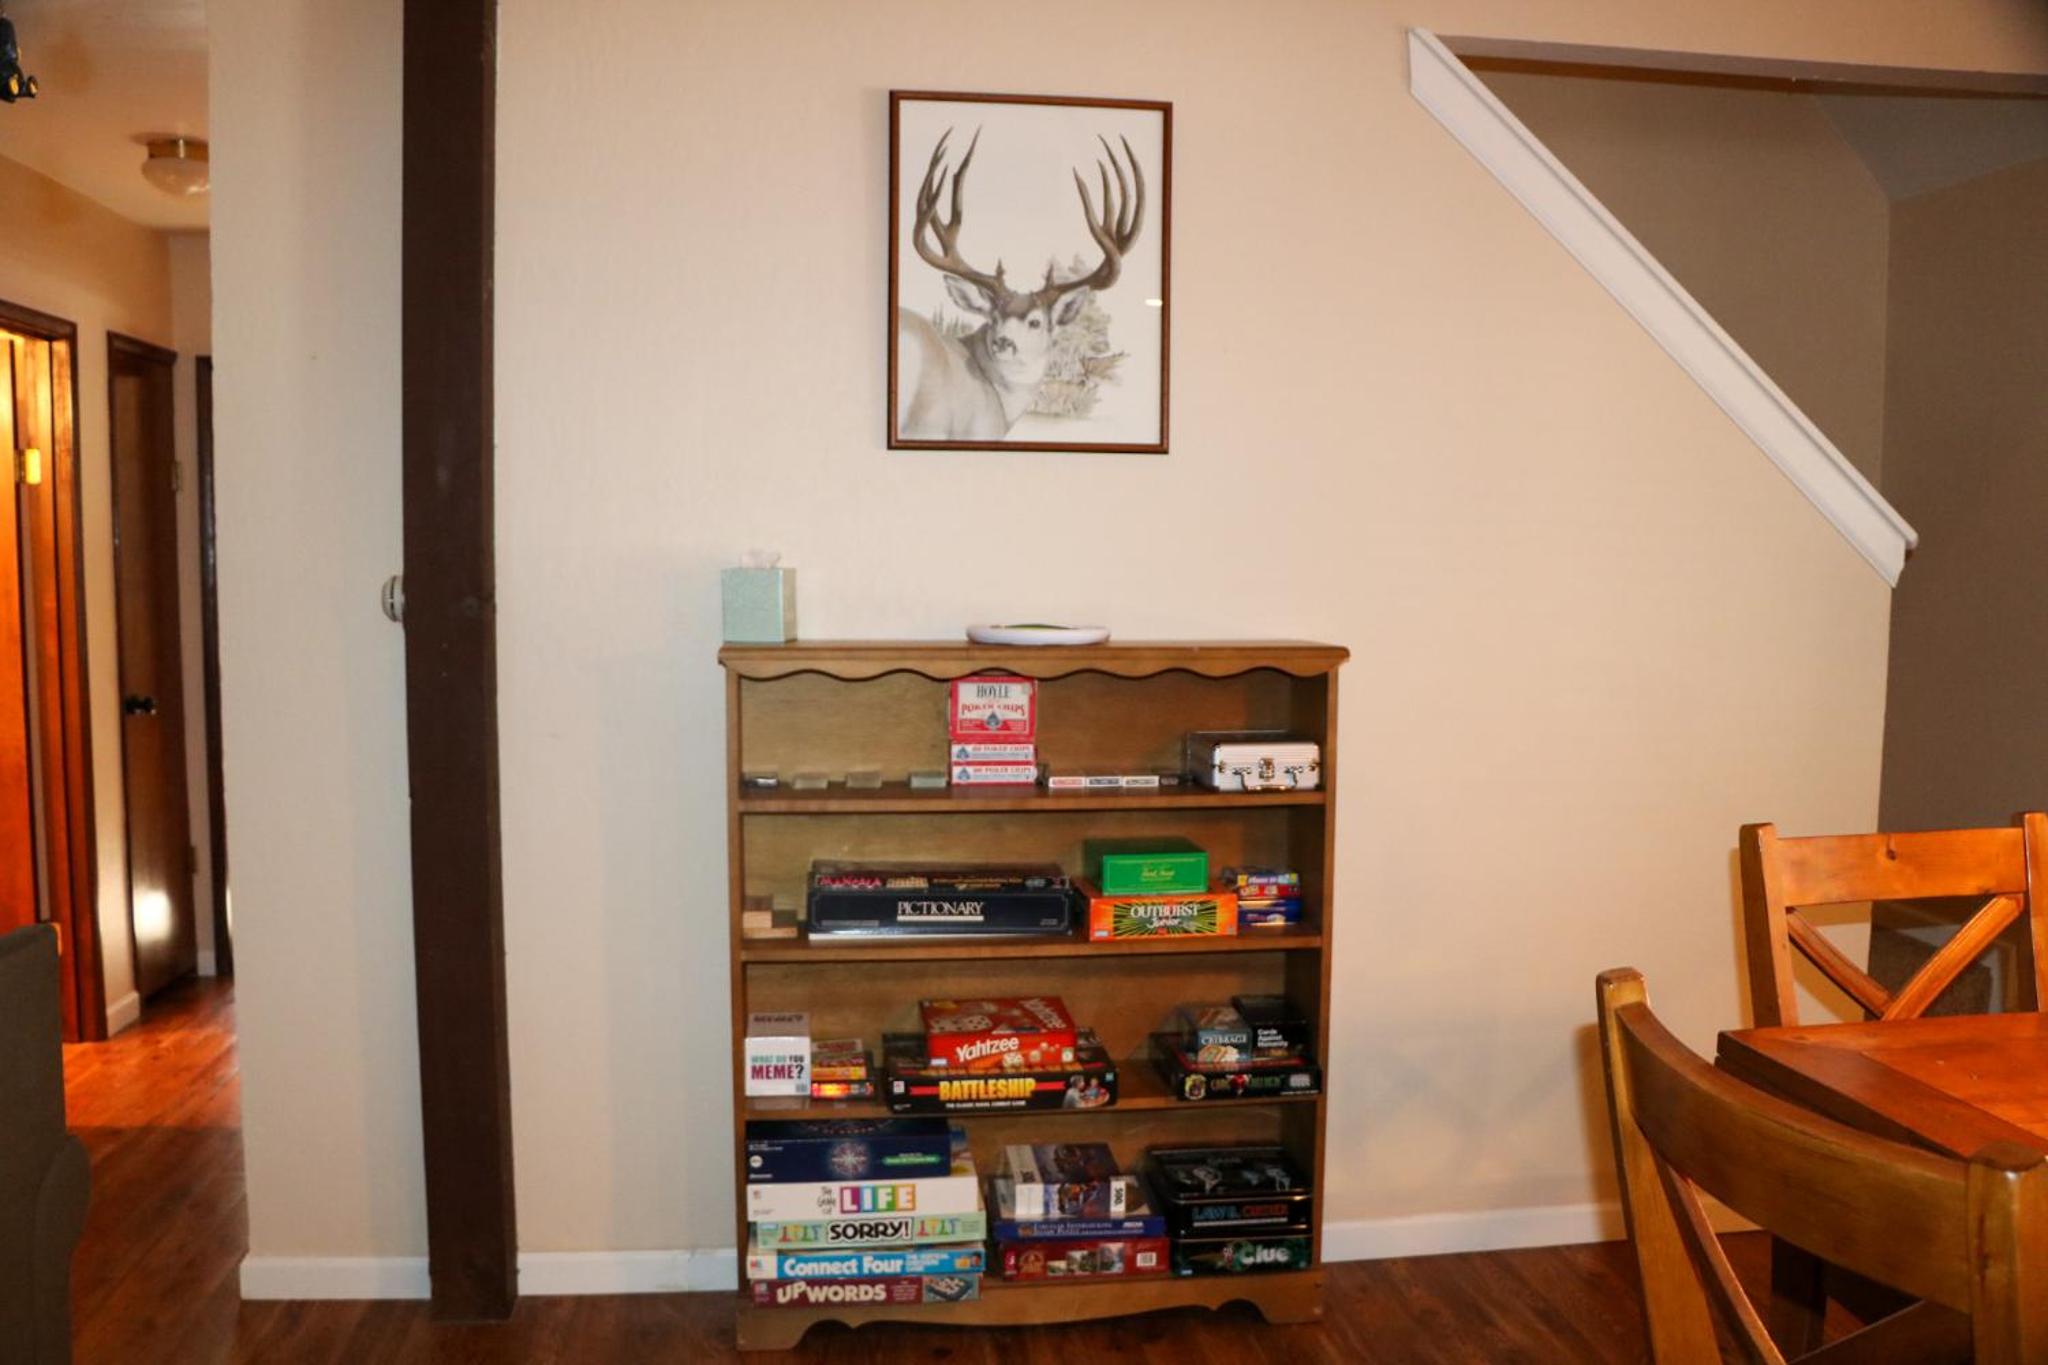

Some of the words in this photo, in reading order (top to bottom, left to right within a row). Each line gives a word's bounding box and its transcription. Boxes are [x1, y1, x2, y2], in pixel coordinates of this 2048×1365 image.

[976, 684, 1009, 698] HOYLE
[961, 703, 996, 716] POKER
[898, 900, 984, 916] PICTIONARY
[1130, 903, 1199, 919] OUTBURST
[1146, 916, 1181, 930] Junior
[1201, 1033, 1247, 1045] CRIBBAGE
[955, 1036, 1020, 1063] Yahtzee
[751, 1055, 775, 1063] WHAT
[789, 1055, 805, 1063] YOU
[751, 1064, 804, 1080] MEME?
[939, 1077, 1037, 1101] BATTLESHIP
[840, 1184, 916, 1213] LIFE
[830, 1217, 911, 1241] SORRY!
[1240, 1245, 1290, 1265] Clue
[783, 1255, 859, 1276] Connect
[862, 1256, 904, 1274] Four
[776, 1280, 887, 1305] UPWORDS
